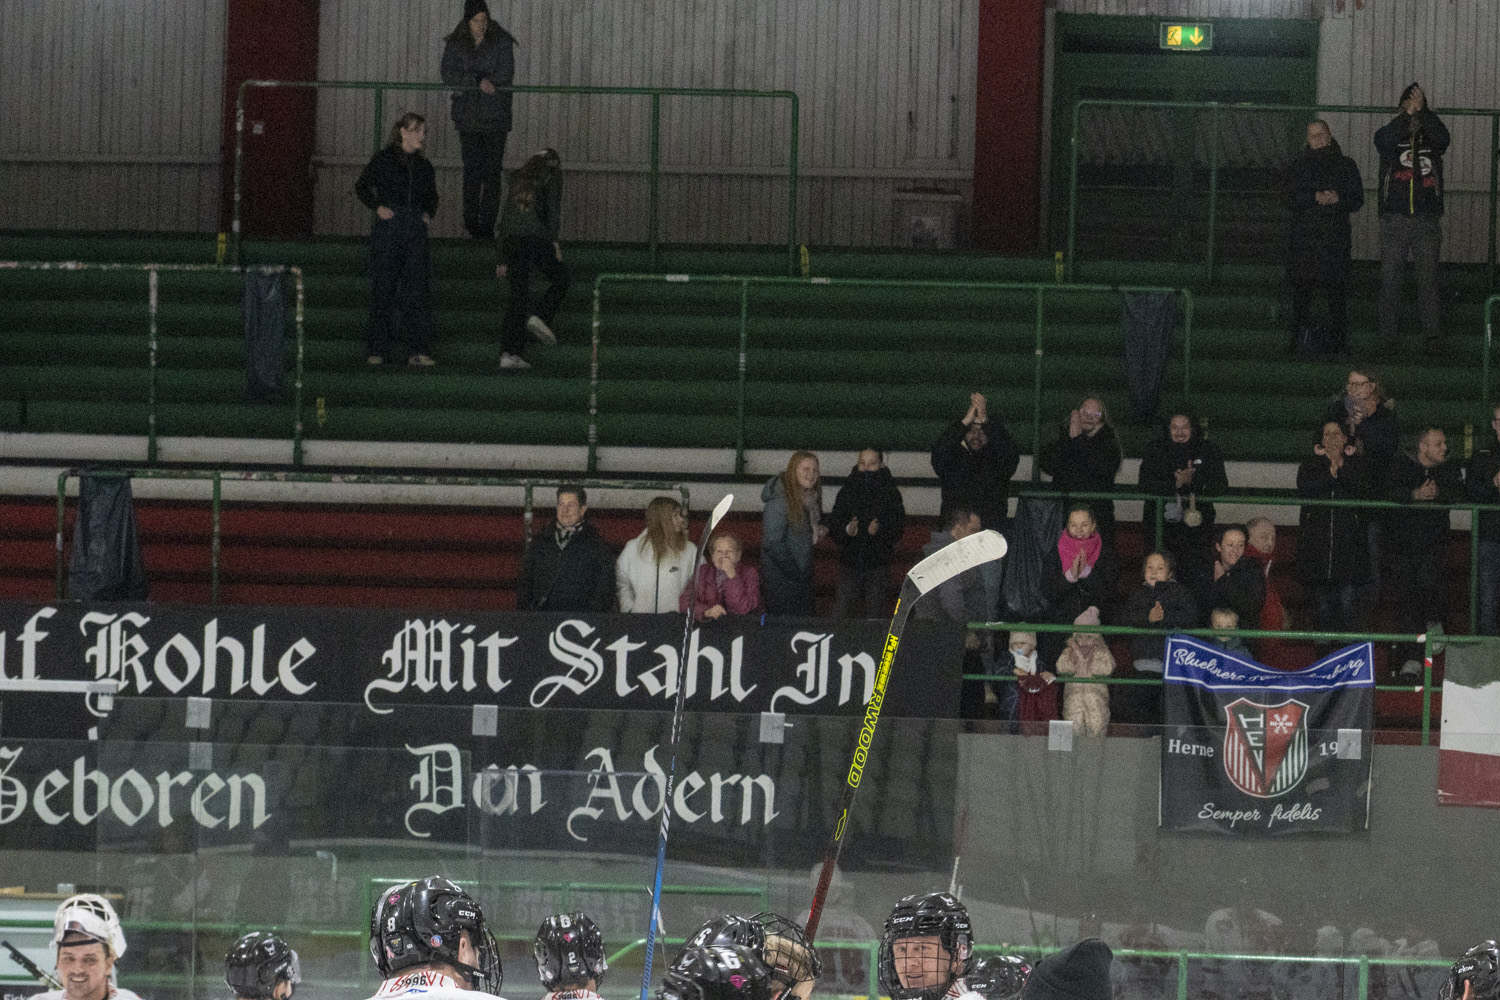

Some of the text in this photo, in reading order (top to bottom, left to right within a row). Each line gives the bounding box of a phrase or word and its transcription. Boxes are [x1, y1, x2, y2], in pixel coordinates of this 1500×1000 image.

[80, 611, 317, 717] Kohle
[365, 619, 518, 714] Mit
[530, 619, 757, 708] Stahl
[771, 631, 877, 728] In
[1168, 739, 1214, 757] Herne
[567, 745, 780, 841] Adern
[1198, 803, 1322, 828] Semper fidelis
[387, 917, 396, 931] 8
[569, 952, 577, 963] 2
